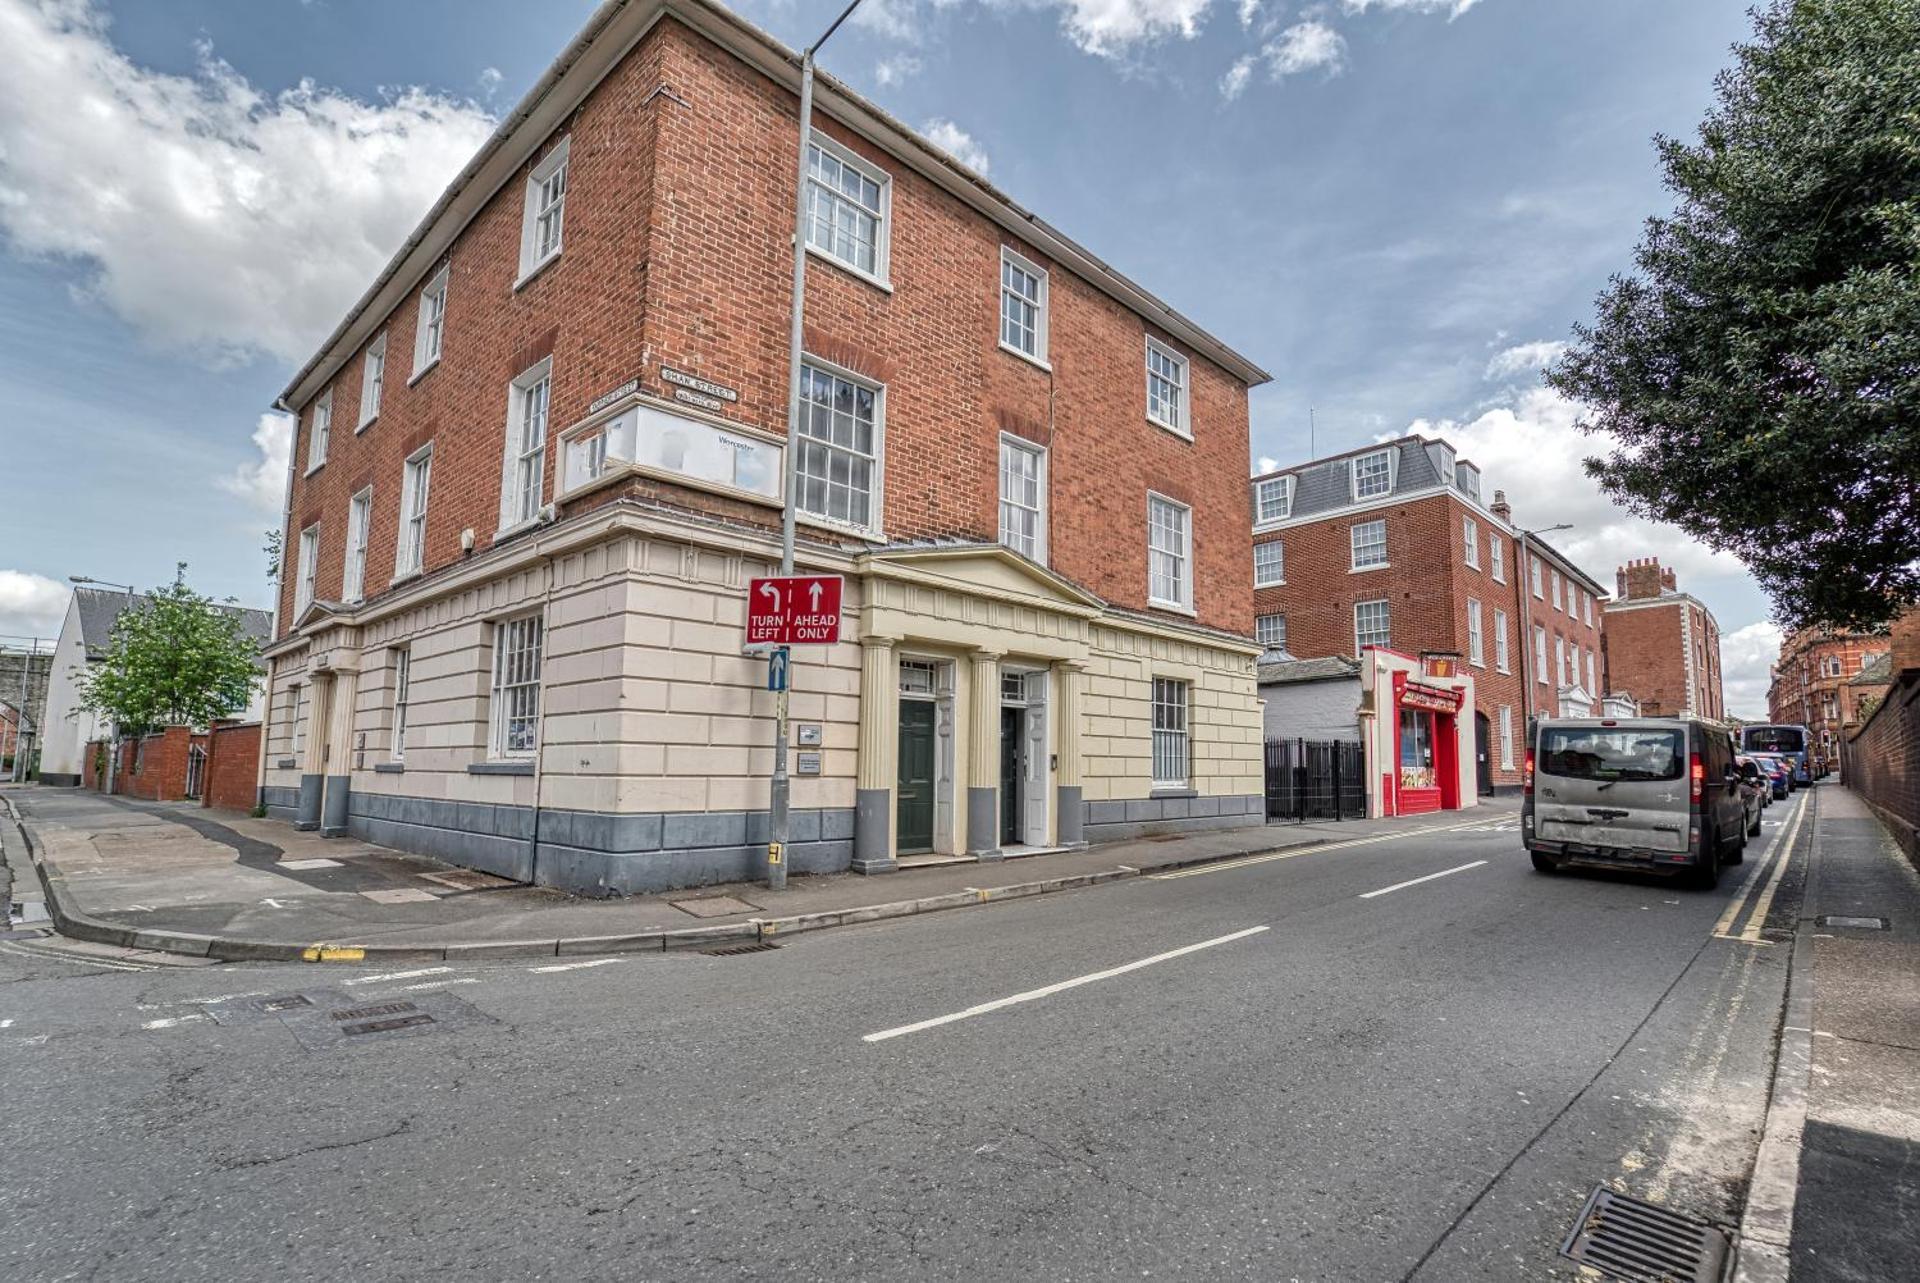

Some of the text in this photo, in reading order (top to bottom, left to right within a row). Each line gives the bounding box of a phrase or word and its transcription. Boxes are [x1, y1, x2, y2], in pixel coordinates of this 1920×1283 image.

[695, 381, 731, 398] STREET
[751, 615, 784, 627] TURN
[794, 615, 837, 626] AHEAD
[751, 628, 780, 639] LEFT
[796, 627, 830, 639] ONLY
